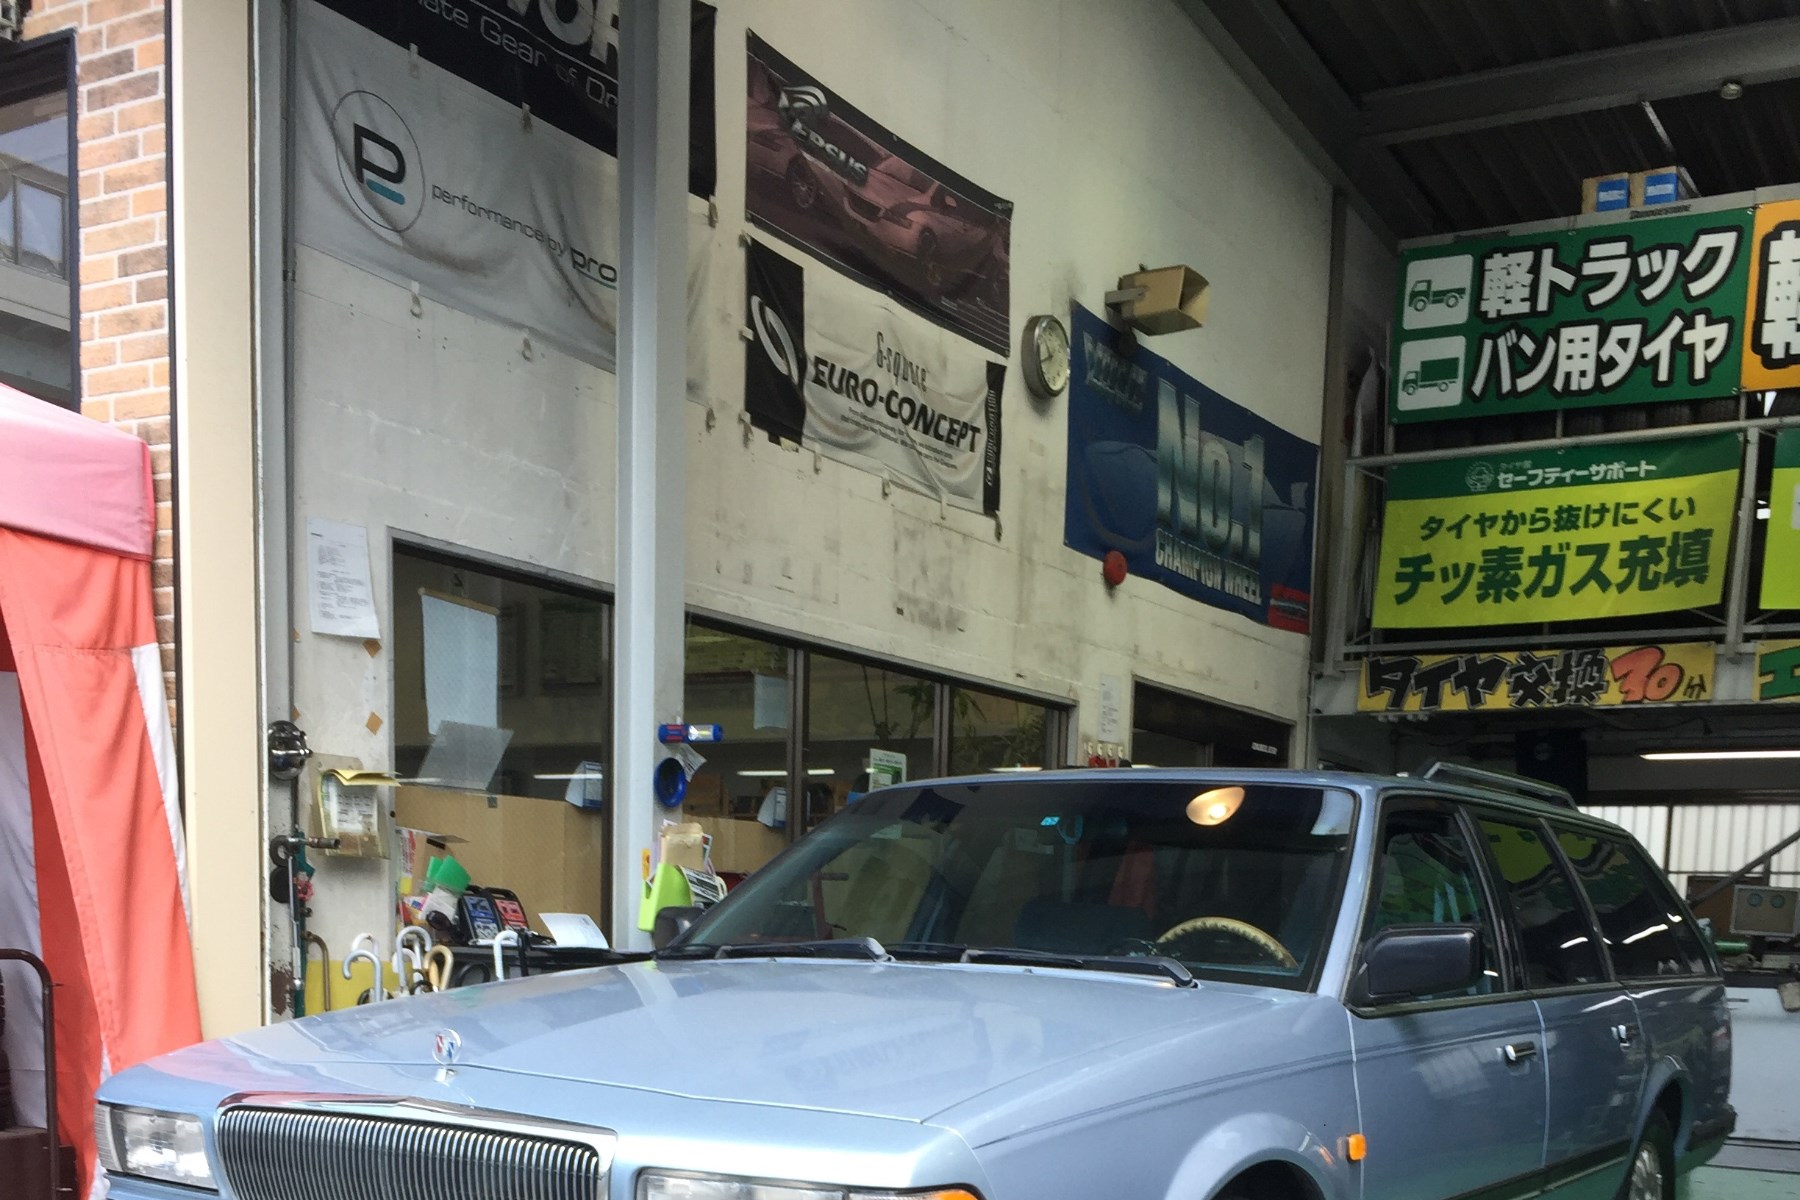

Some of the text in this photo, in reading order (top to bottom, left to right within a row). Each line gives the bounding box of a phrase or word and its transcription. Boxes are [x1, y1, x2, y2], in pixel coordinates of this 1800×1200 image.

[480, 15, 547, 68] Gear
[431, 183, 546, 242] performance
[570, 246, 618, 284] pro
[1479, 230, 1739, 319] 軽トラック
[1470, 313, 1730, 397] バン用タイヤ
[812, 354, 982, 453] EURO-CONCEPT
[1496, 459, 1658, 489] セーフティーサポート
[1419, 496, 1696, 542] タイヤから抜けにくい
[1394, 527, 1715, 606] チッ素ガス充填
